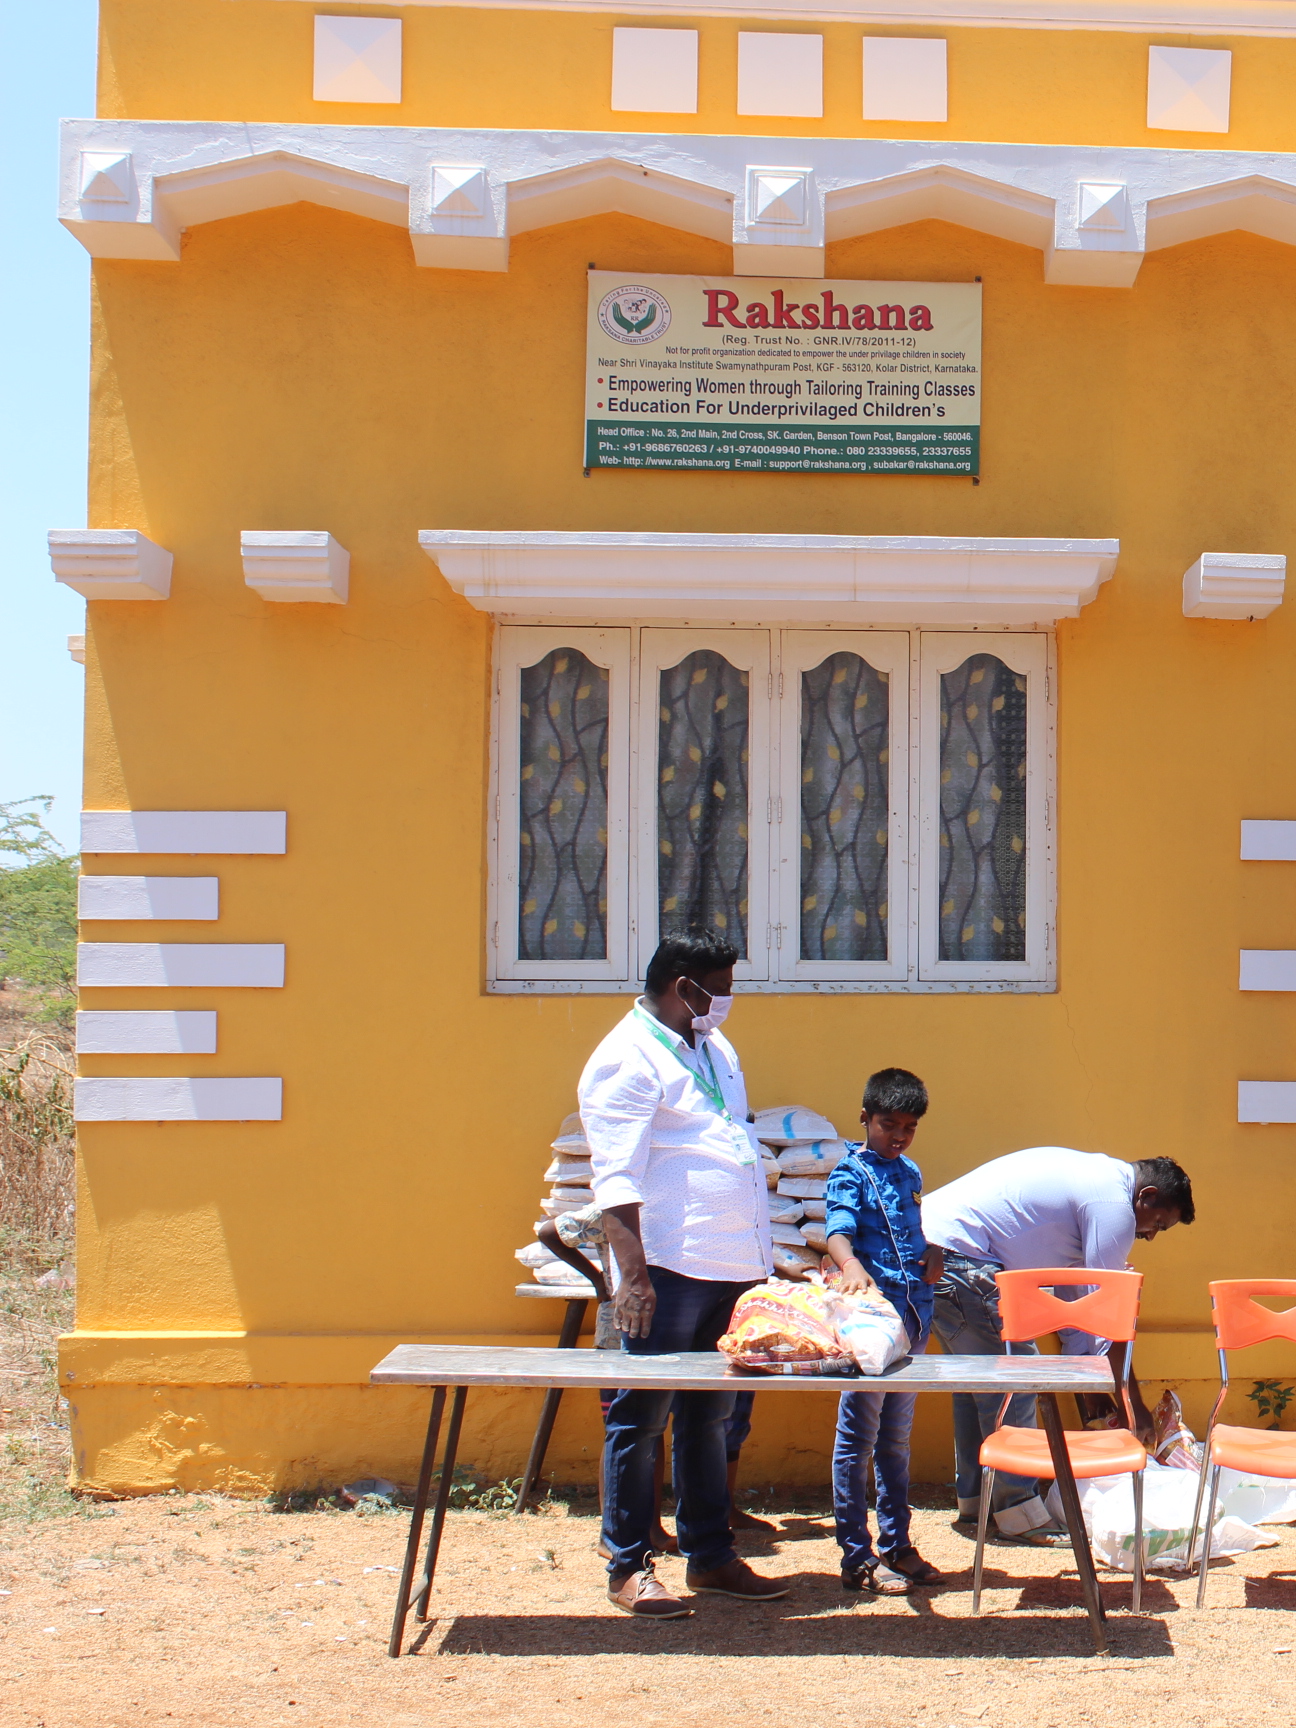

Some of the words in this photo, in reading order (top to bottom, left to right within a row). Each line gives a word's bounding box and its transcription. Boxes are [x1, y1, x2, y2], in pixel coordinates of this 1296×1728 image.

[702, 289, 934, 331] Rakshana
[722, 335, 749, 346] (Reg.
[755, 335, 781, 344] Trust
[786, 336, 802, 345] No.
[814, 336, 916, 348] GNR.IV/78/2011-12)
[692, 347, 710, 356] profit
[713, 348, 756, 357] organization
[758, 348, 791, 357] dedicated
[802, 351, 834, 359] empower
[871, 351, 900, 360] privilage
[903, 351, 930, 359] children
[941, 351, 965, 360] society
[598, 358, 617, 367] Near
[620, 358, 636, 367] Shri
[640, 359, 677, 370] Vinayaka
[680, 360, 713, 369] Institute
[716, 360, 790, 373] Swamynathpuram
[793, 363, 814, 372] Post,
[816, 363, 834, 372] KGF
[842, 364, 873, 374] 563120,
[876, 364, 898, 372] Kolar
[900, 364, 932, 374] District,
[935, 365, 978, 373] Karnataka.
[609, 375, 691, 396] Empowering
[696, 378, 745, 394] Women
[750, 379, 801, 398] through
[806, 380, 862, 399] Tailoring
[867, 381, 919, 400] Training
[924, 381, 975, 396] Classes
[608, 398, 690, 413] Education
[696, 400, 723, 414] For
[729, 400, 857, 420] Underprivilaged
[598, 427, 618, 436] Head
[621, 427, 644, 437] Office
[652, 429, 665, 437] No.
[667, 429, 679, 439] 26,
[681, 429, 696, 438] 2nd
[698, 430, 719, 439] Main,
[722, 430, 737, 438] 2nd
[739, 431, 765, 440] Cross,
[768, 431, 781, 440] SK.
[784, 431, 815, 441] Garden,
[817, 432, 847, 440] Benson
[850, 432, 871, 440] Town
[874, 432, 894, 442] Post,
[896, 432, 936, 442] Bangalore
[944, 433, 973, 441] 560046.
[599, 442, 619, 451] Ph.:
[623, 443, 707, 453] +91-9686760263
[716, 445, 800, 455] +91-9740049940
[846, 447, 865, 455] 080
[868, 447, 919, 457] 23339655,
[923, 447, 971, 456] 23337655
[599, 456, 621, 465] Web-
[735, 459, 761, 468] E-mail
[769, 459, 866, 471] support@rakshana.org
[874, 460, 970, 471] subakar@rakshana.org
